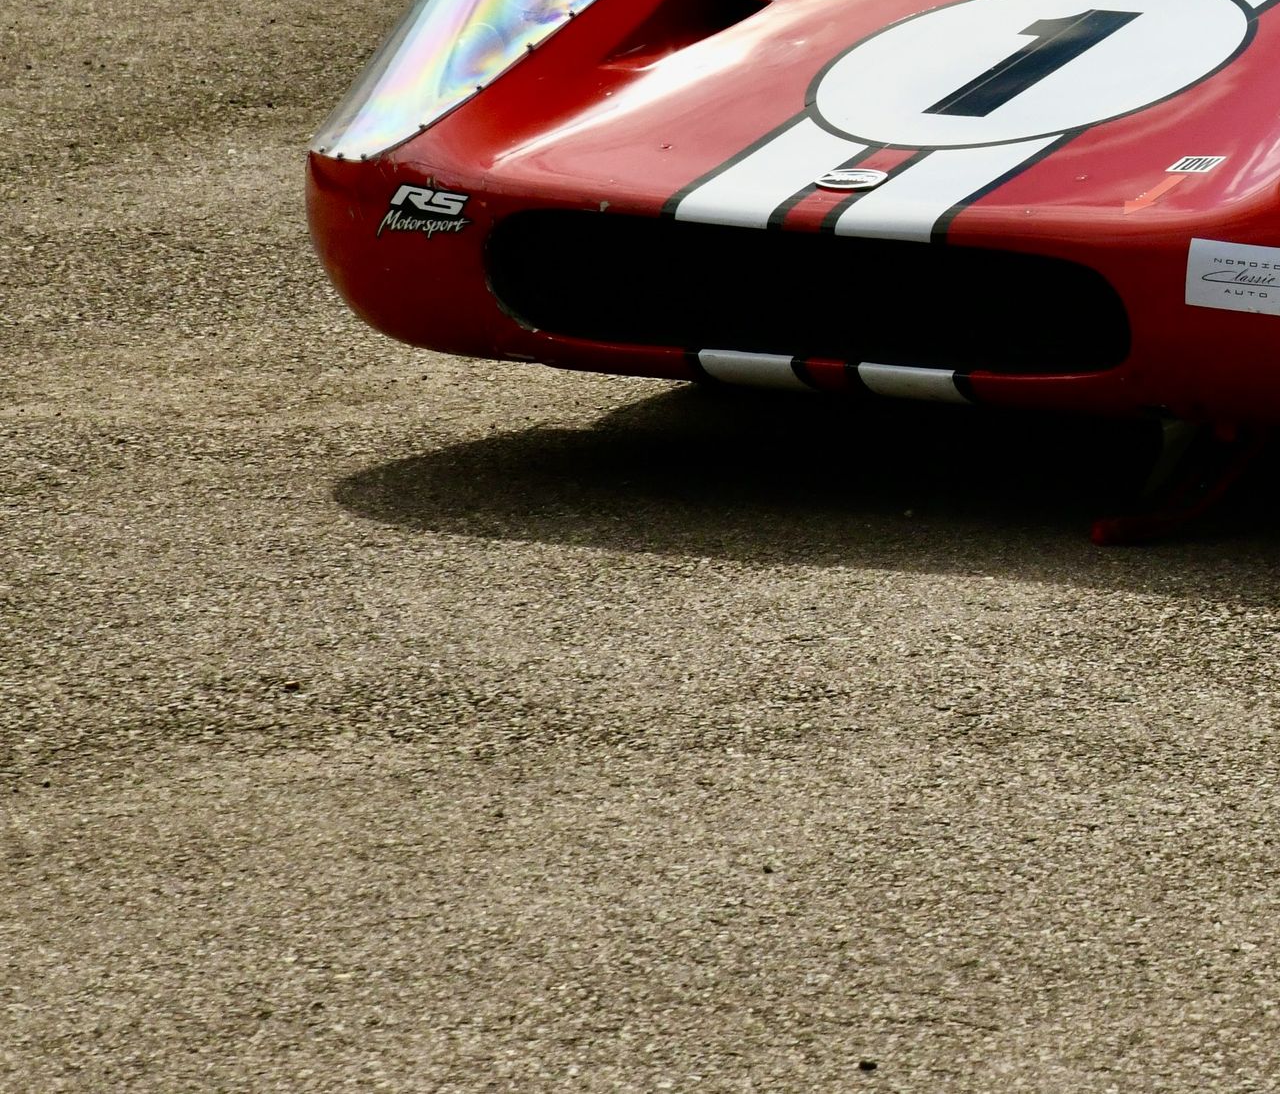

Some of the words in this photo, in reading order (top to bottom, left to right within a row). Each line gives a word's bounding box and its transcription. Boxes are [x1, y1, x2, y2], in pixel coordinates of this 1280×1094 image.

[920, 8, 1144, 118] 1
[1172, 157, 1223, 171] TOW
[389, 184, 469, 216] RS
[376, 209, 472, 239] Motorsport
[1223, 288, 1268, 299] AUTO
